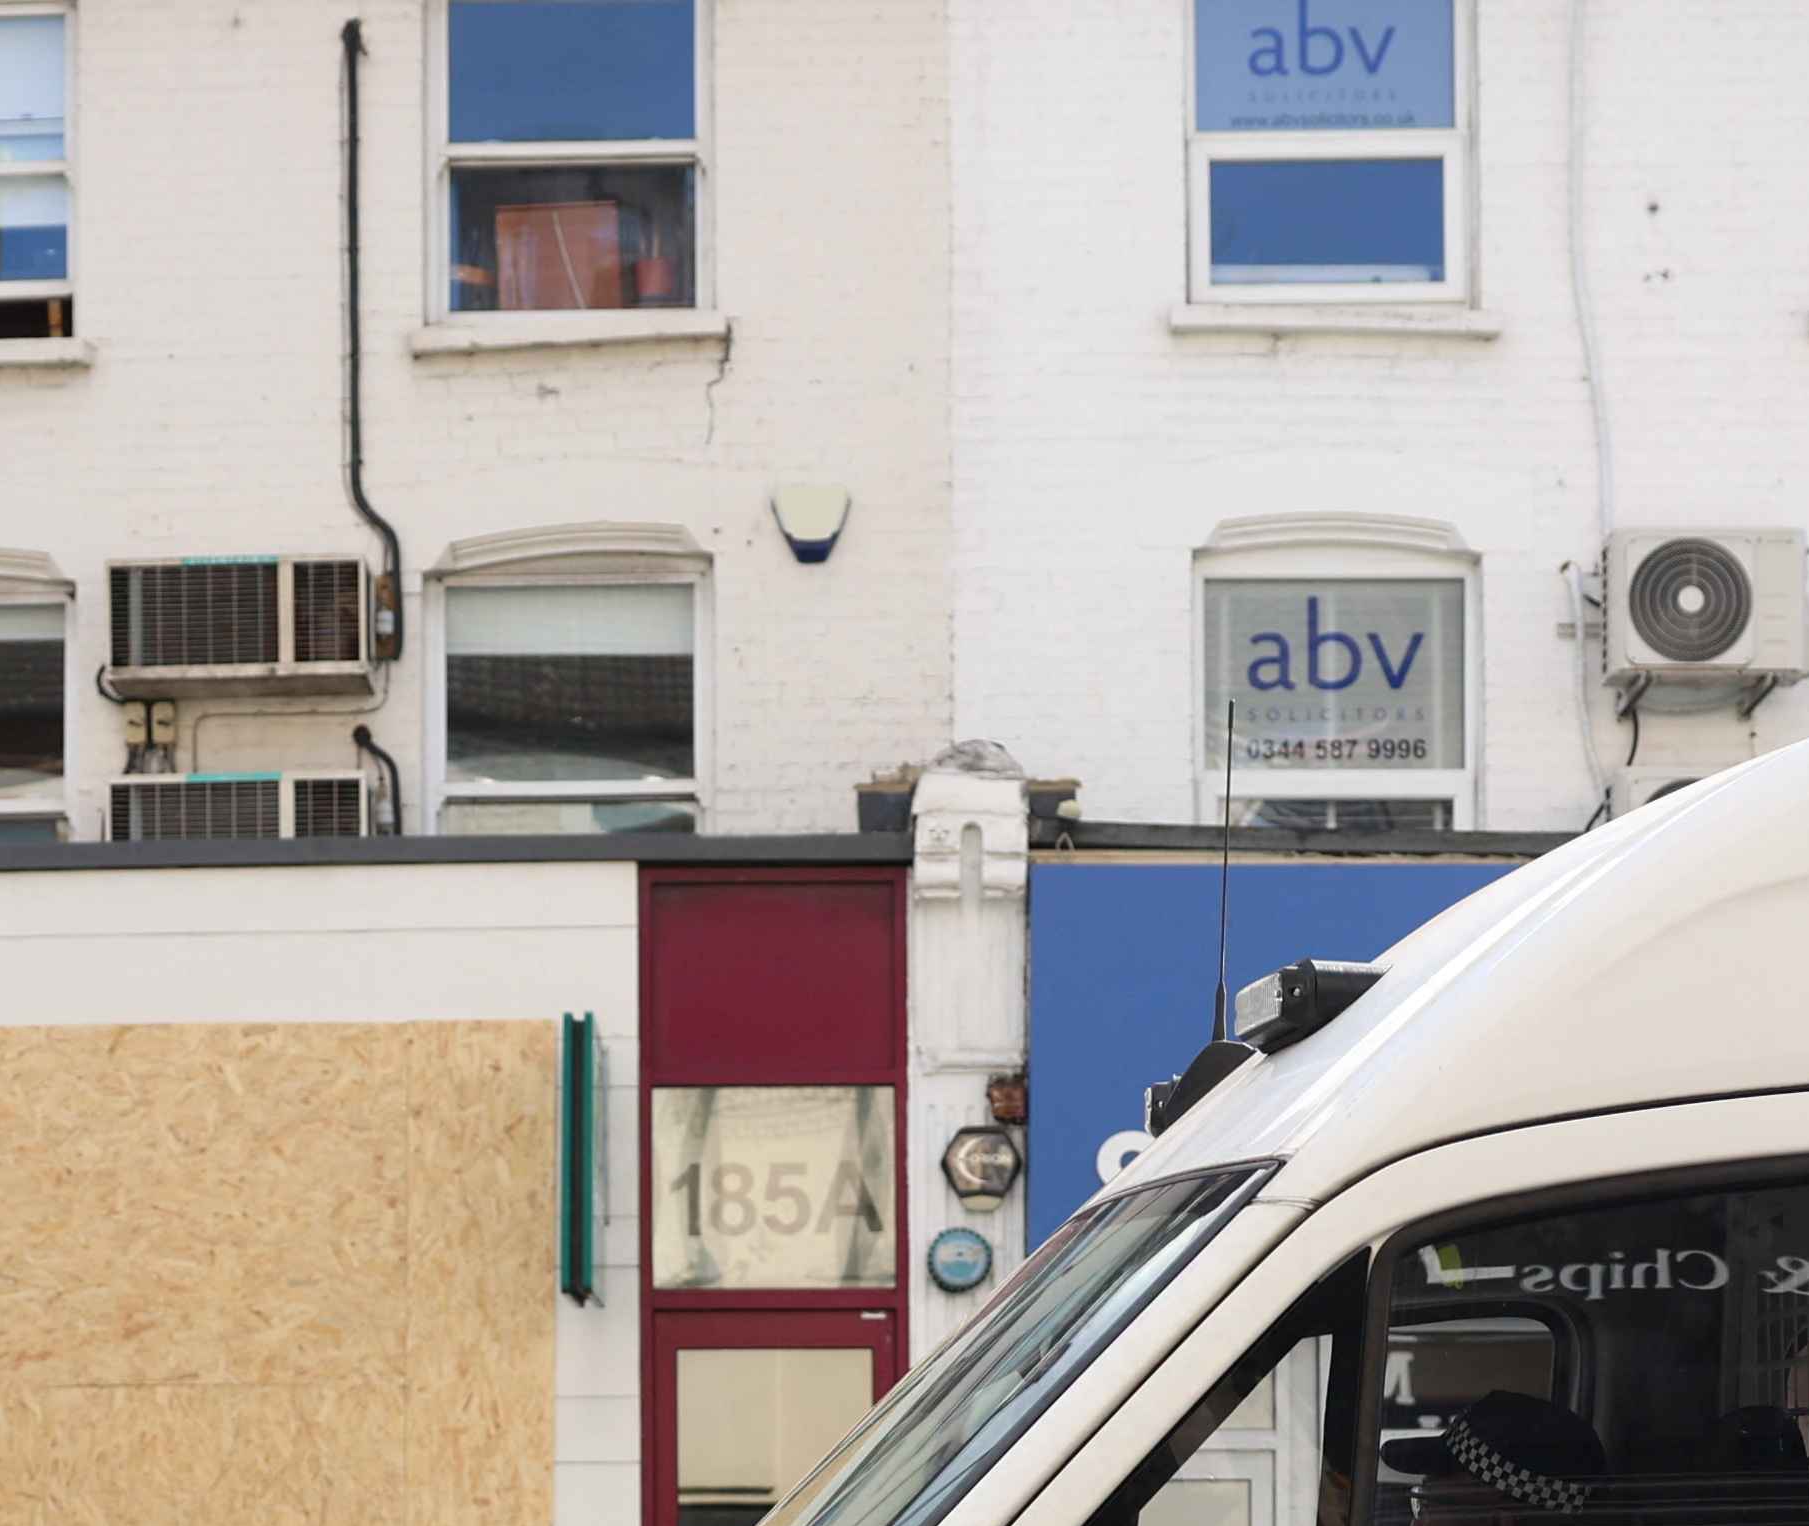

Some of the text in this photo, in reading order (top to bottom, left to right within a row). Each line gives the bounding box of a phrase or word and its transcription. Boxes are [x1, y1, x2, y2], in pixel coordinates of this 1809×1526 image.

[1248, 0, 1396, 76] abv
[1246, 595, 1425, 691] abv
[1247, 705, 1426, 722] SOLICITORS
[1247, 738, 1427, 759] 0344 587 9996
[670, 1160, 884, 1237] 185A
